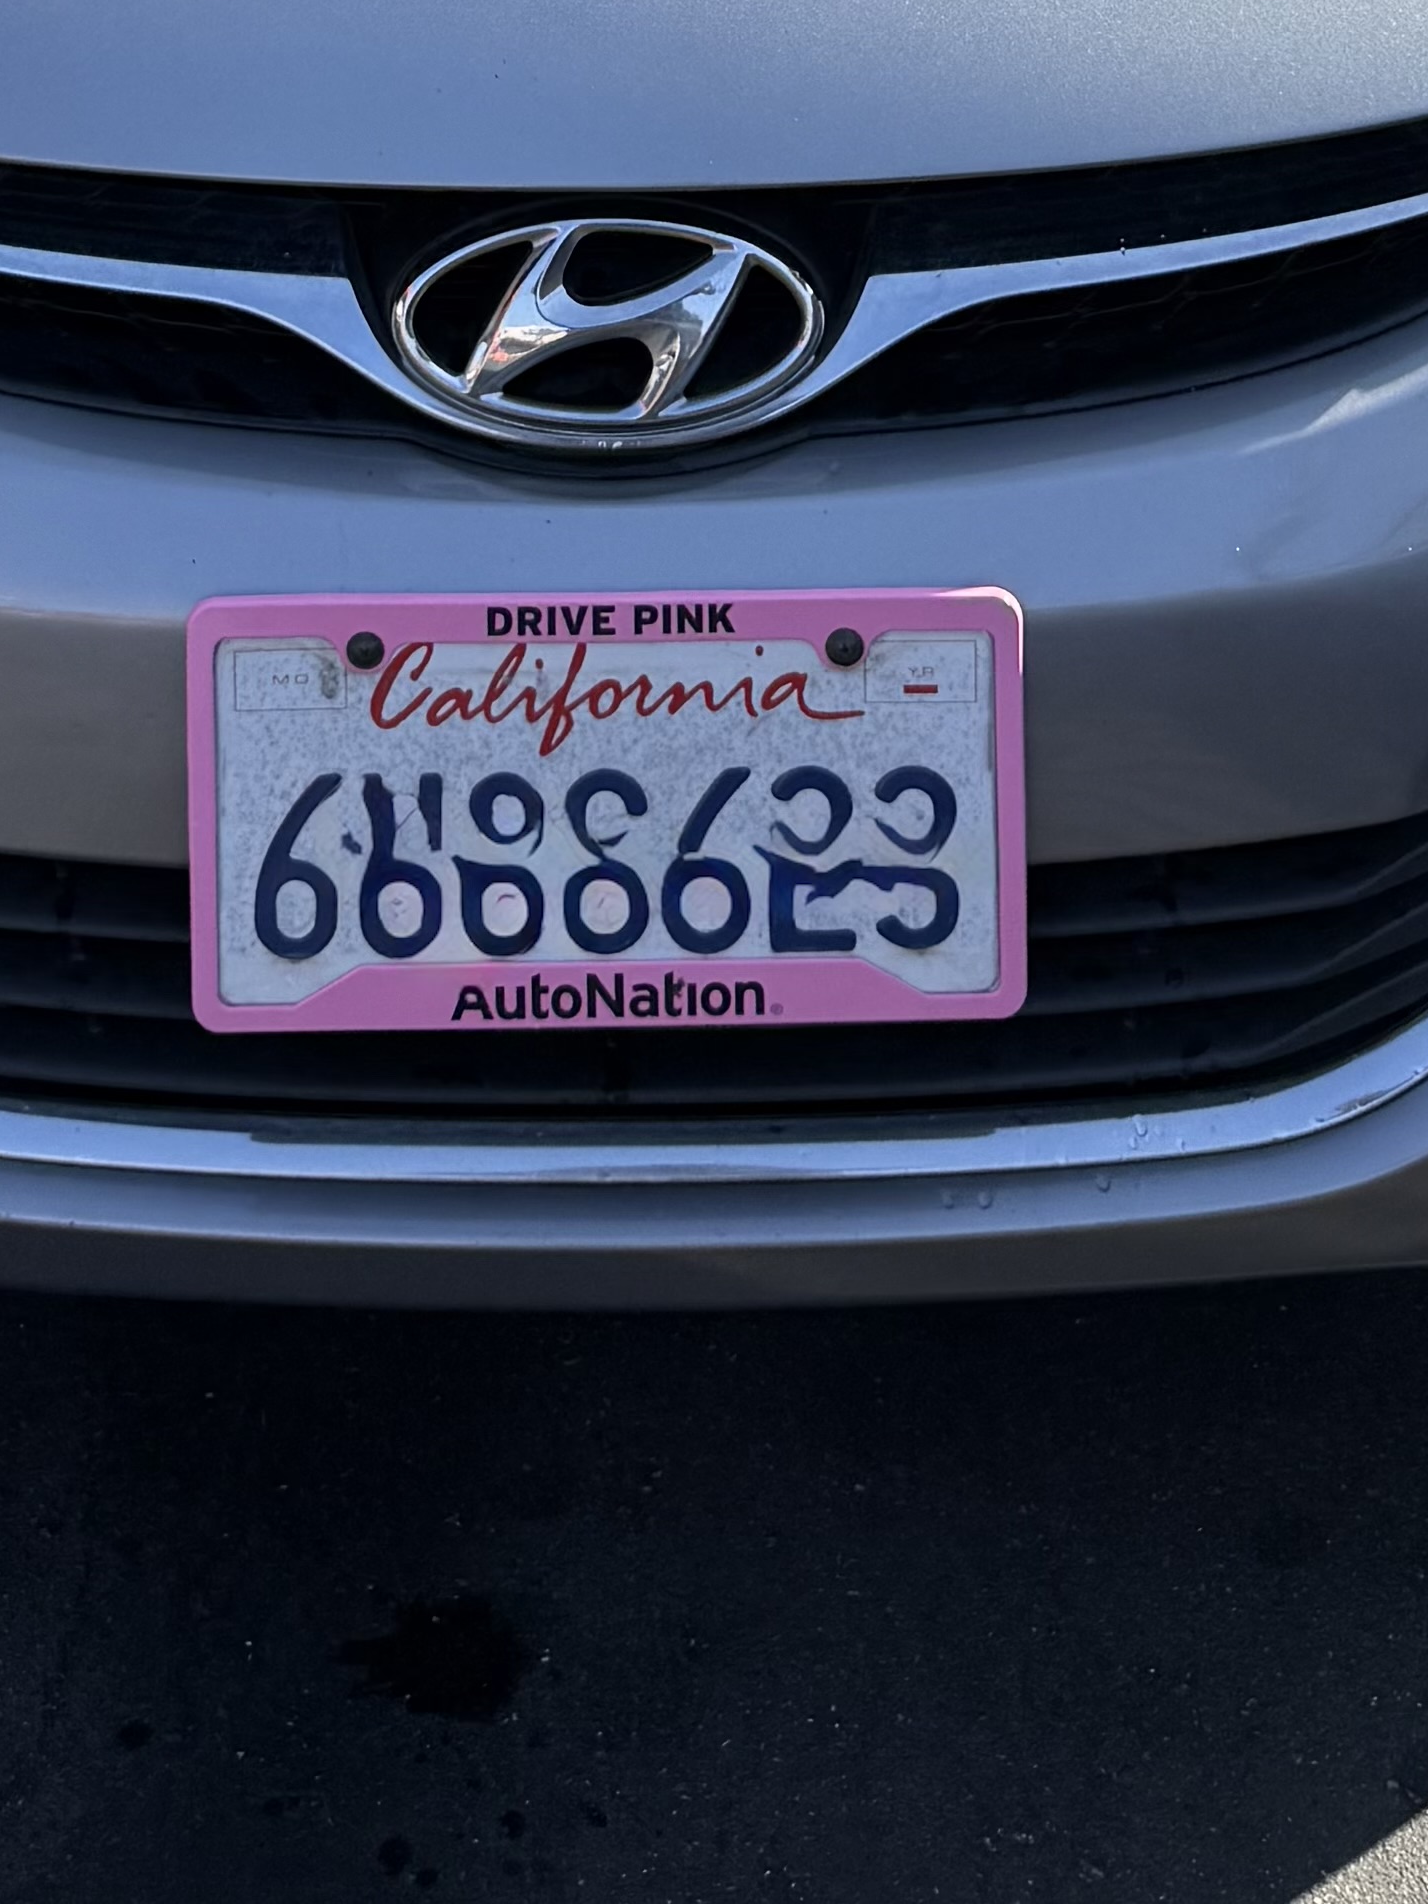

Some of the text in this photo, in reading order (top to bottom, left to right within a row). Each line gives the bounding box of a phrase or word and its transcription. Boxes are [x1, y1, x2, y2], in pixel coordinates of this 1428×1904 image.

[486, 603, 735, 637] DRIVE PINK
[272, 673, 310, 686] MO
[371, 641, 865, 757] California
[451, 971, 766, 1021] AutoNation
